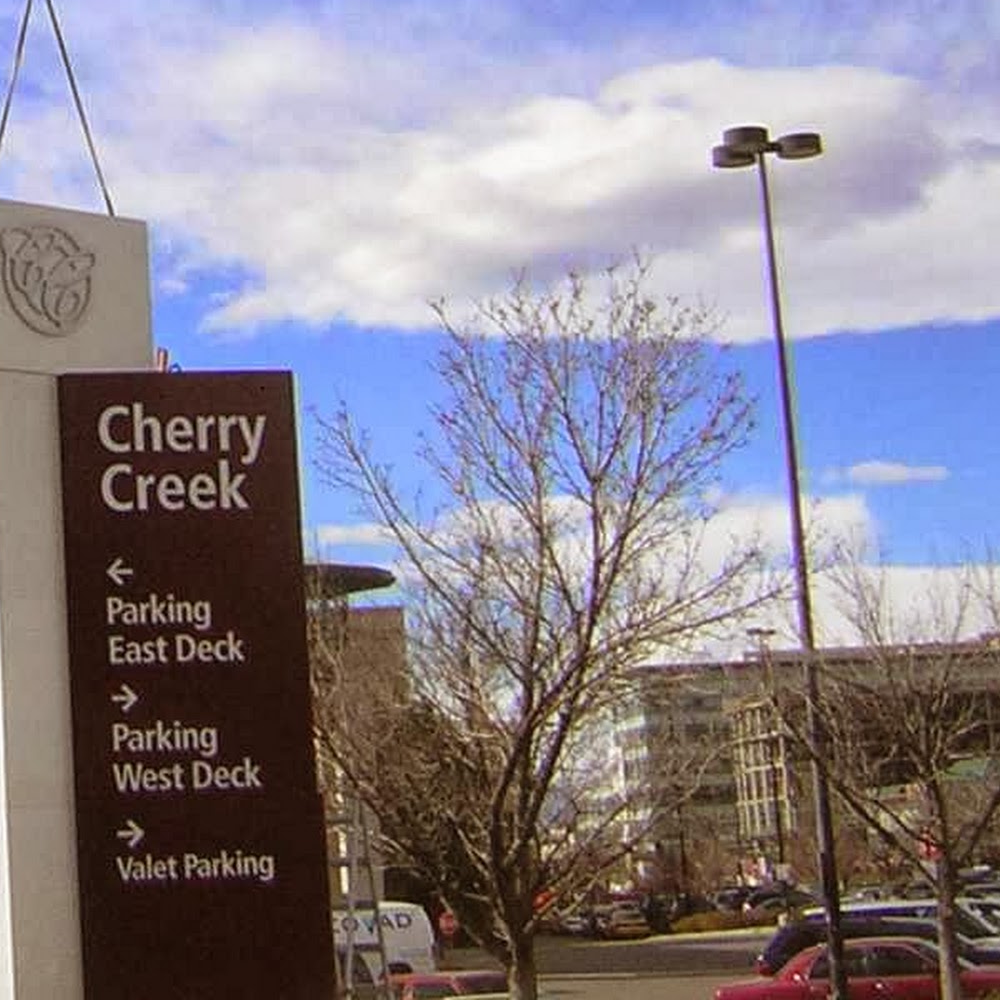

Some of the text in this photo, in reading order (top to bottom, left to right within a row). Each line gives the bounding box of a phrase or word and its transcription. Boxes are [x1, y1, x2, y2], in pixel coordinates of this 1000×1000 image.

[98, 402, 266, 466] Cherry
[101, 459, 249, 513] Creek
[106, 593, 212, 631] Parking
[108, 631, 246, 665] East Deck
[112, 720, 219, 757] Parking
[112, 757, 263, 792] West Deck
[116, 850, 275, 881] Valet Parking
